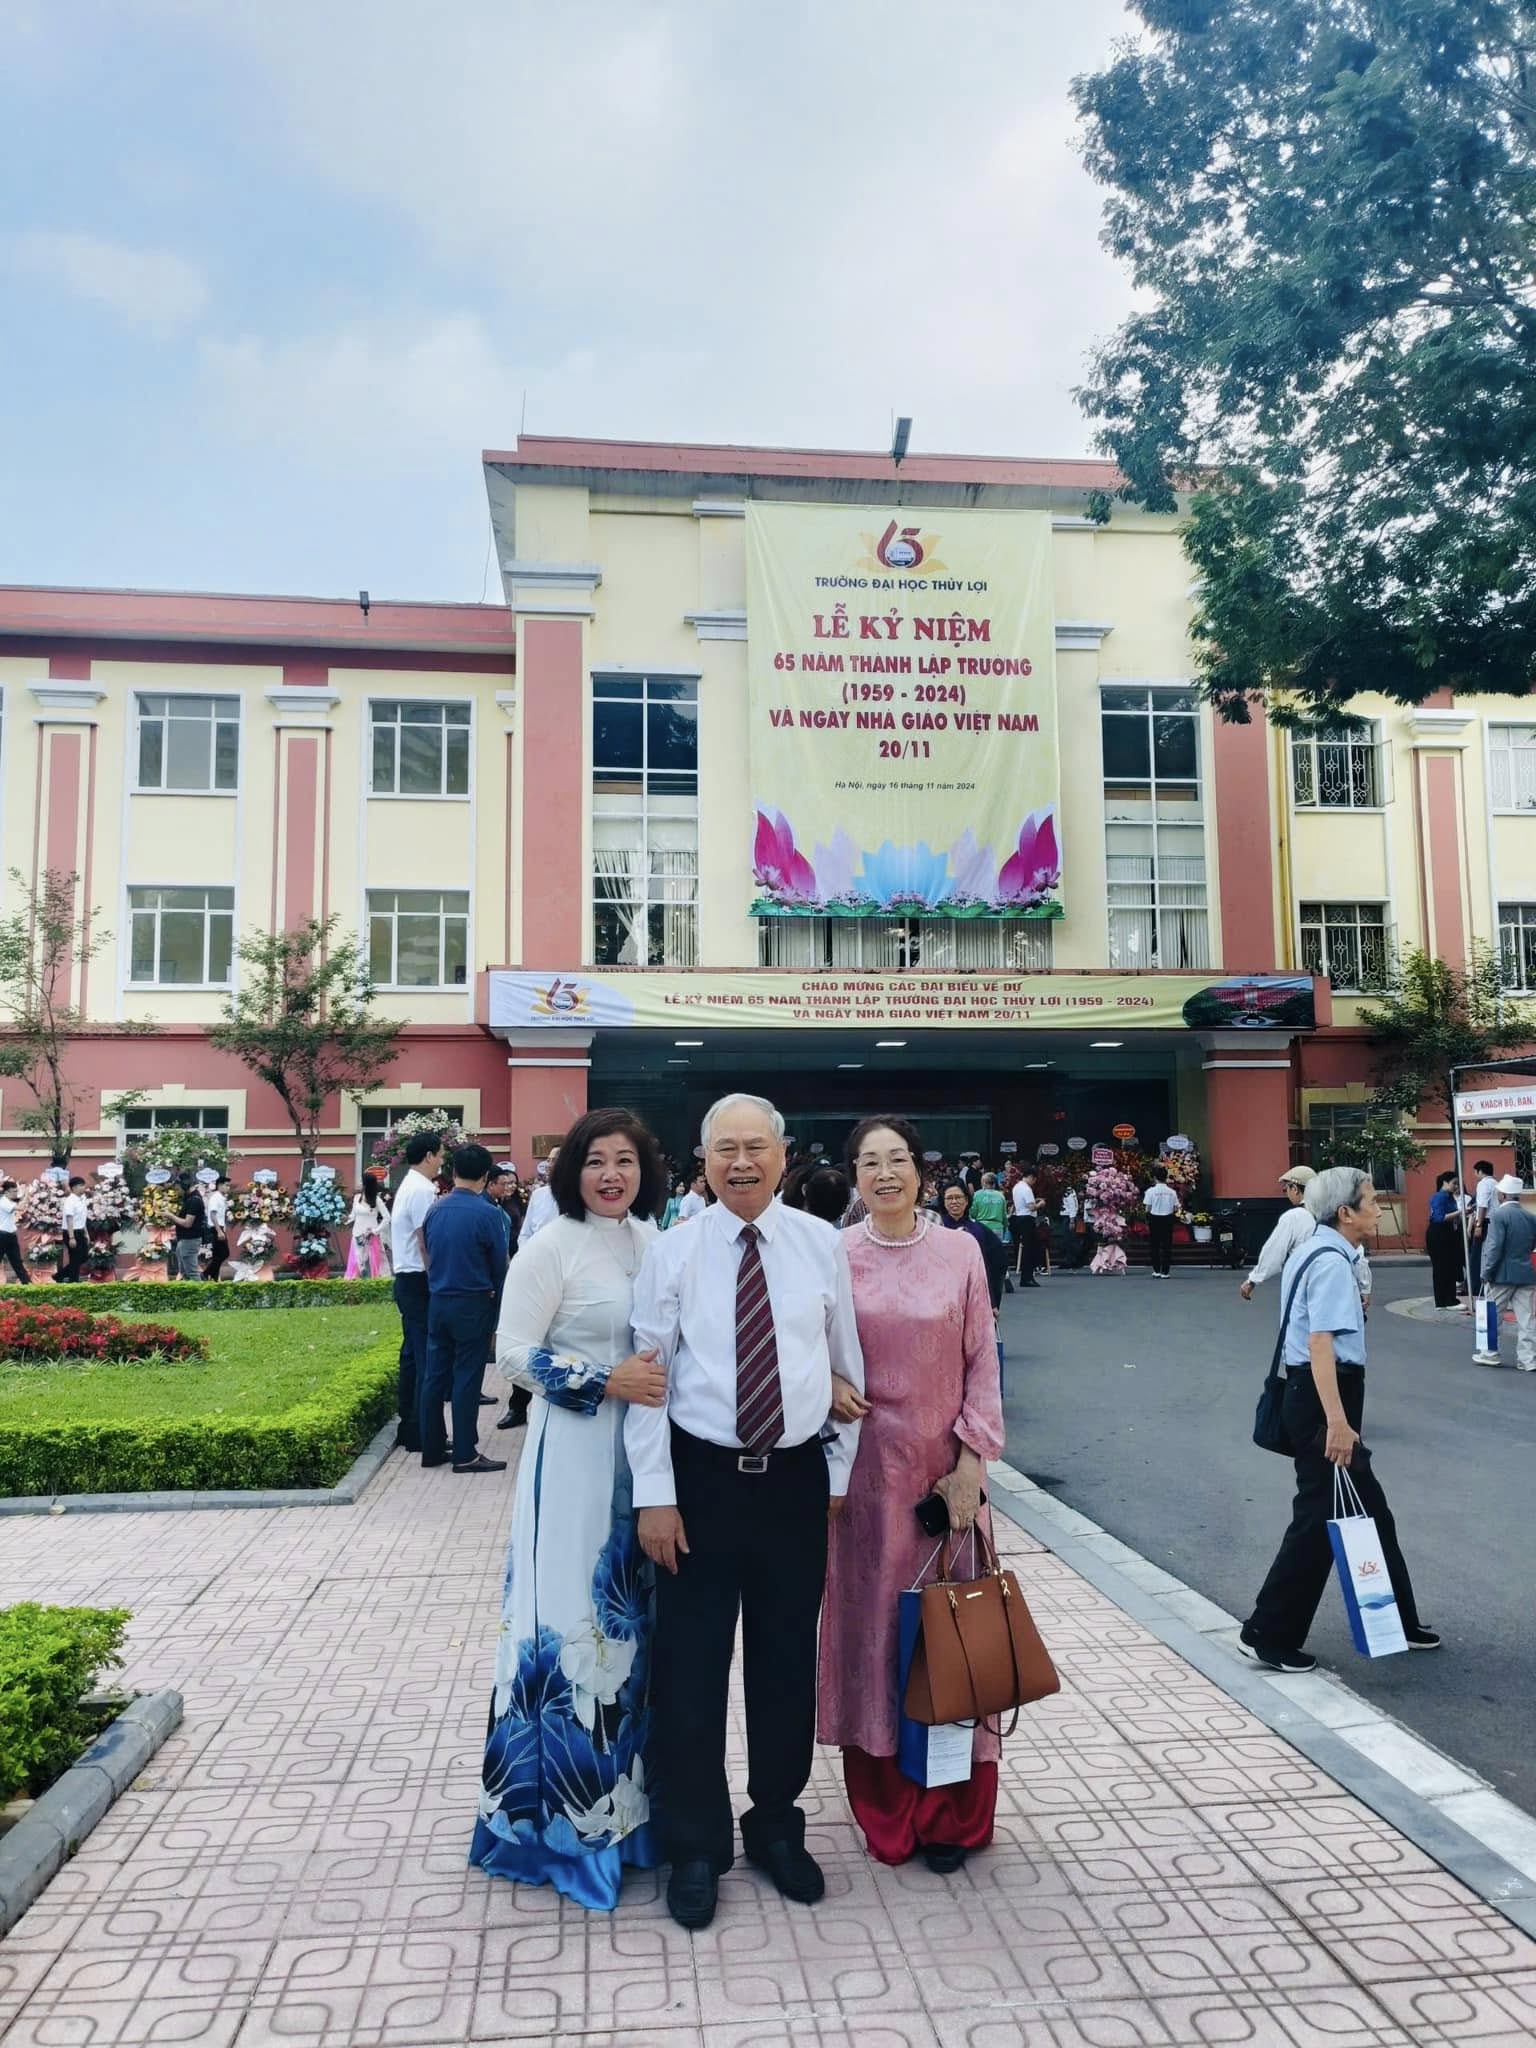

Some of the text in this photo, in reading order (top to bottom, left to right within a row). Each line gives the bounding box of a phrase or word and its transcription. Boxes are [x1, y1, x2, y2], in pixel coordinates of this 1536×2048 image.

[877, 519, 924, 568] 65
[815, 575, 987, 593] TRƯỜNG ĐẠI HỌC THỦY LỢI
[813, 602, 991, 648] LỄ KỶ NIỆM
[774, 651, 1032, 679] 65 NĂM THÀNH LẬP TRƯỜNG
[842, 682, 895, 705] (1959
[914, 684, 966, 706] 2024)
[769, 705, 1039, 736] VÀ NGÀY NHÀ GIÁO VIỆT NAM
[879, 740, 930, 760] 20/11
[889, 781, 899, 789] 16
[546, 978, 579, 1011] 65
[921, 982, 943, 993] ĐẠI
[747, 995, 764, 1005] 65
[944, 996, 966, 1007] ĐẠI
[971, 996, 998, 1007] HỌC
[1040, 996, 1061, 1007] LỢI
[1066, 996, 1103, 1006] (1959
[1117, 996, 1154, 1006] 2024)
[958, 1009, 989, 1019] NAM
[994, 1010, 1031, 1019] 20/11
